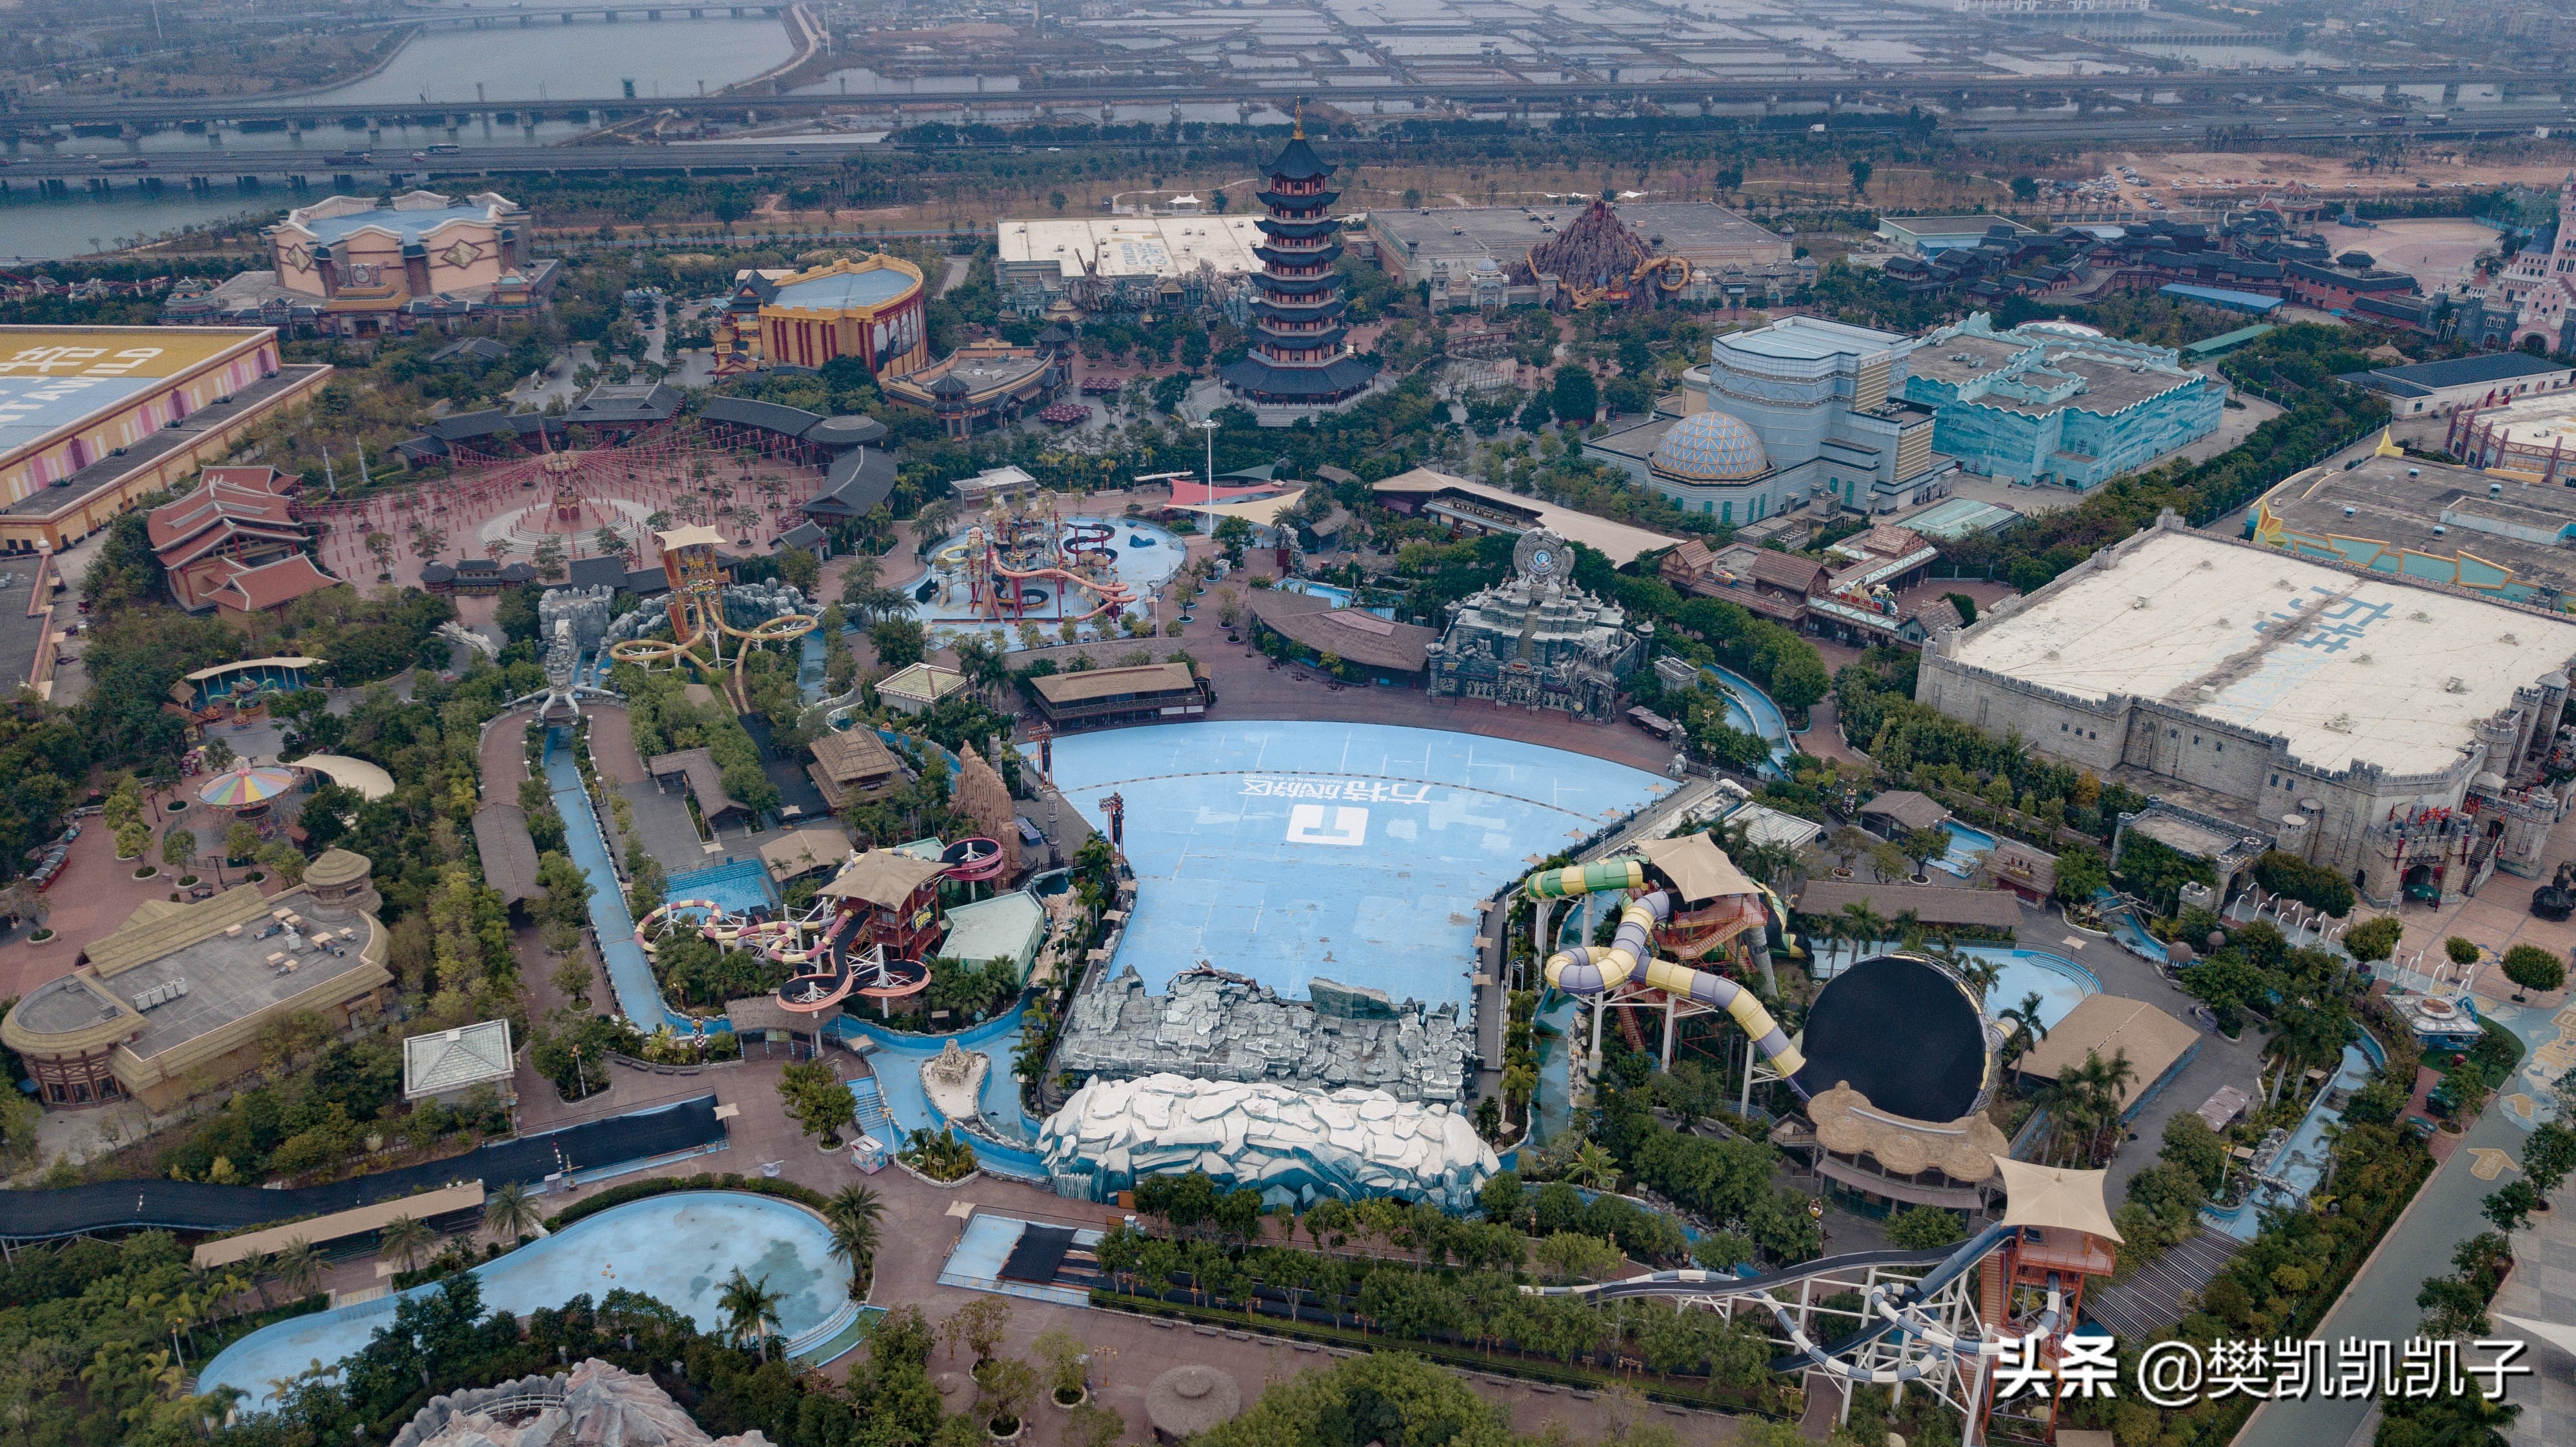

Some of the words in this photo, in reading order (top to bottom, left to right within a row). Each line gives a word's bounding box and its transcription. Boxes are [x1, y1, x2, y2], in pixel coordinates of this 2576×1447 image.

[1238, 778, 1432, 804] 方特旅游区
